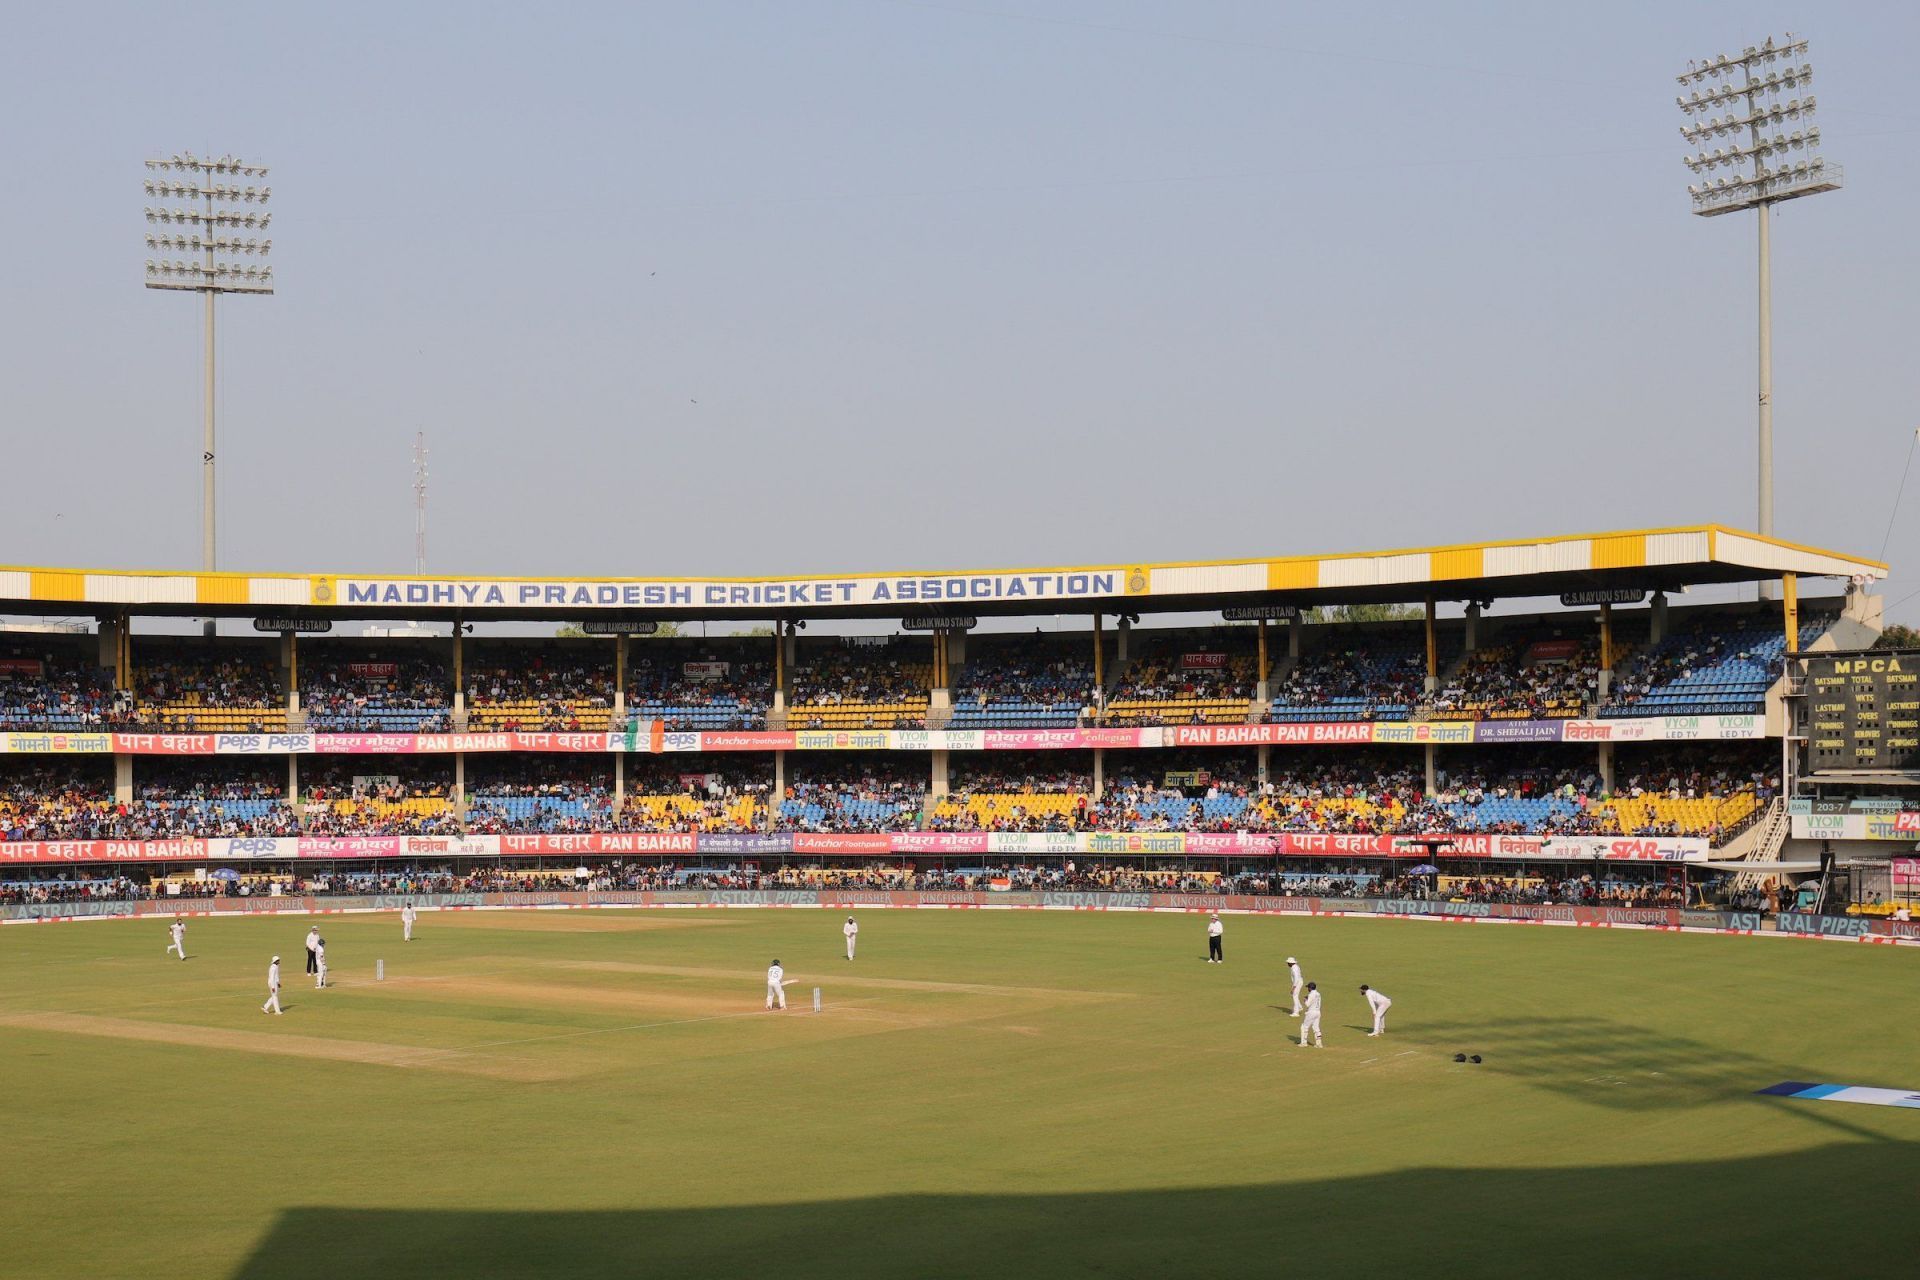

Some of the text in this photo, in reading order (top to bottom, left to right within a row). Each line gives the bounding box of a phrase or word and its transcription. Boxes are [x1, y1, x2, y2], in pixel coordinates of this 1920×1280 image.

[348, 574, 1113, 604] MADHYA PRADESH CRICKET ASSOCIATION
[1614, 589, 1641, 600] STAND
[1270, 606, 1295, 617] STAND
[305, 620, 329, 631] STAND
[639, 622, 655, 632] STAND
[951, 617, 975, 627] STAND
[1834, 659, 1901, 673] MPCA
[1815, 677, 1845, 685] BATSMAN
[1886, 675, 1917, 683] BATSMAN
[1855, 694, 1874, 702] WKTS
[1815, 704, 1846, 712] LASTMAN
[1718, 716, 1754, 728] VYOM
[1857, 712, 1879, 720] OVERS
[1664, 717, 1699, 728] VYOM
[900, 731, 929, 740] VYOM
[945, 731, 975, 740] VYOM
[1180, 725, 1369, 742] PAN BAHAR PAN BAHAR
[1376, 724, 1416, 742] गोमती
[1430, 723, 1472, 741] गोमती
[1480, 727, 1556, 737] DR. SHEFALI JAIN
[1565, 722, 1612, 740] विठोबा
[1666, 731, 1684, 739] LED
[1740, 730, 1753, 738] TV
[9, 733, 51, 751] गोमती
[68, 733, 109, 751] गोमती
[118, 734, 208, 752] पान बहार
[417, 735, 508, 749] PAN BAHAR
[516, 733, 600, 751] पान बहार
[713, 736, 793, 746] Anchor Toothpaste
[798, 732, 835, 748] गोमती
[851, 732, 888, 748] गोमती
[986, 731, 1075, 744] मोयरा मोयरा
[1855, 749, 1876, 757] EXTRAS
[1791, 803, 1808, 811] BAN
[1817, 803, 1844, 812] 203-7
[1807, 816, 1843, 827] VYOM
[506, 835, 594, 852] पान बहार
[601, 836, 692, 850] PAN BAHAR
[806, 838, 844, 848] Anchor
[845, 840, 887, 850] Toothpaste
[892, 834, 984, 846] मोयरा मोयरा
[998, 834, 1028, 843] VYOM
[1046, 834, 1077, 843] VYOM
[1144, 834, 1182, 852] गोमती
[1291, 834, 1328, 850] पान
[1333, 834, 1382, 854] बहार
[0, 841, 96, 860] पान बहार
[107, 841, 204, 857] PAN BAHAR
[1605, 839, 1698, 862] STAR air
[374, 894, 435, 909] ASTRAL
[441, 893, 485, 906] PIPES
[503, 893, 559, 905] KINGFISHER
[587, 891, 643, 904] KINGFISHER
[710, 891, 768, 904] ASTRAL
[776, 891, 817, 904] PIPES
[836, 891, 893, 903] KINGFISHER
[920, 892, 975, 904] KINGFISHER
[1042, 893, 1105, 906] ASTRAL
[1107, 893, 1150, 907] PIPES
[1170, 895, 1226, 910] KINGFISHER
[155, 900, 216, 913] KINGFISHER
[245, 899, 304, 911] KINGFISHER
[1255, 896, 1309, 911] KINGFISHER
[1376, 900, 1436, 914] ASTRAL
[1443, 903, 1490, 917] PIPES
[17, 902, 134, 919] ASTRAL PIPES
[1511, 906, 1575, 921] KINGFISHER
[1606, 909, 1667, 924] KINGFISHER
[1729, 913, 1760, 930] AST
[1820, 915, 1870, 937] PIPES
